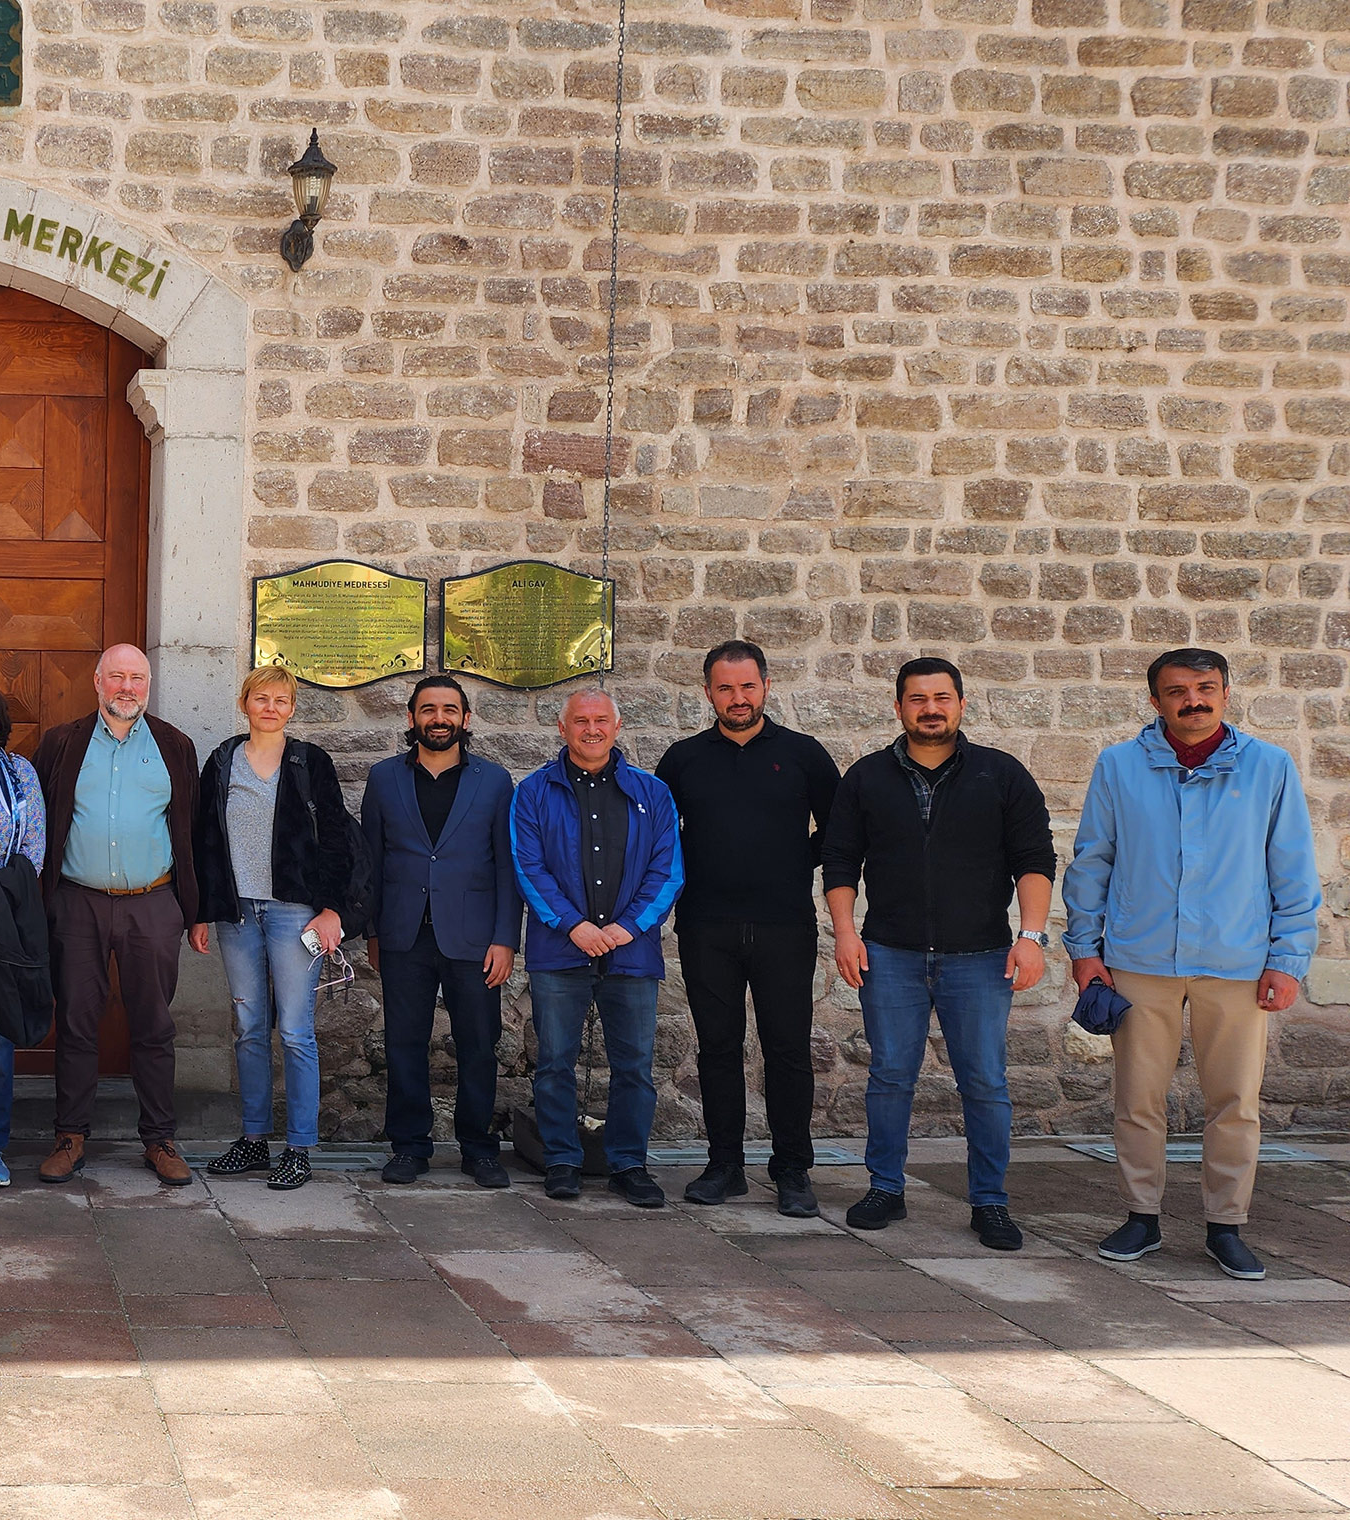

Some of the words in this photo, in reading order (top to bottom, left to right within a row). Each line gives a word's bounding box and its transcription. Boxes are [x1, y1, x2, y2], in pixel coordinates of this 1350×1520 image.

[3, 207, 171, 300] MERKEZİ
[292, 579, 342, 589] MAHMUDİYE
[343, 579, 391, 589] MEDRESESİ
[512, 579, 527, 588] ALİ
[528, 580, 546, 588] GAV
